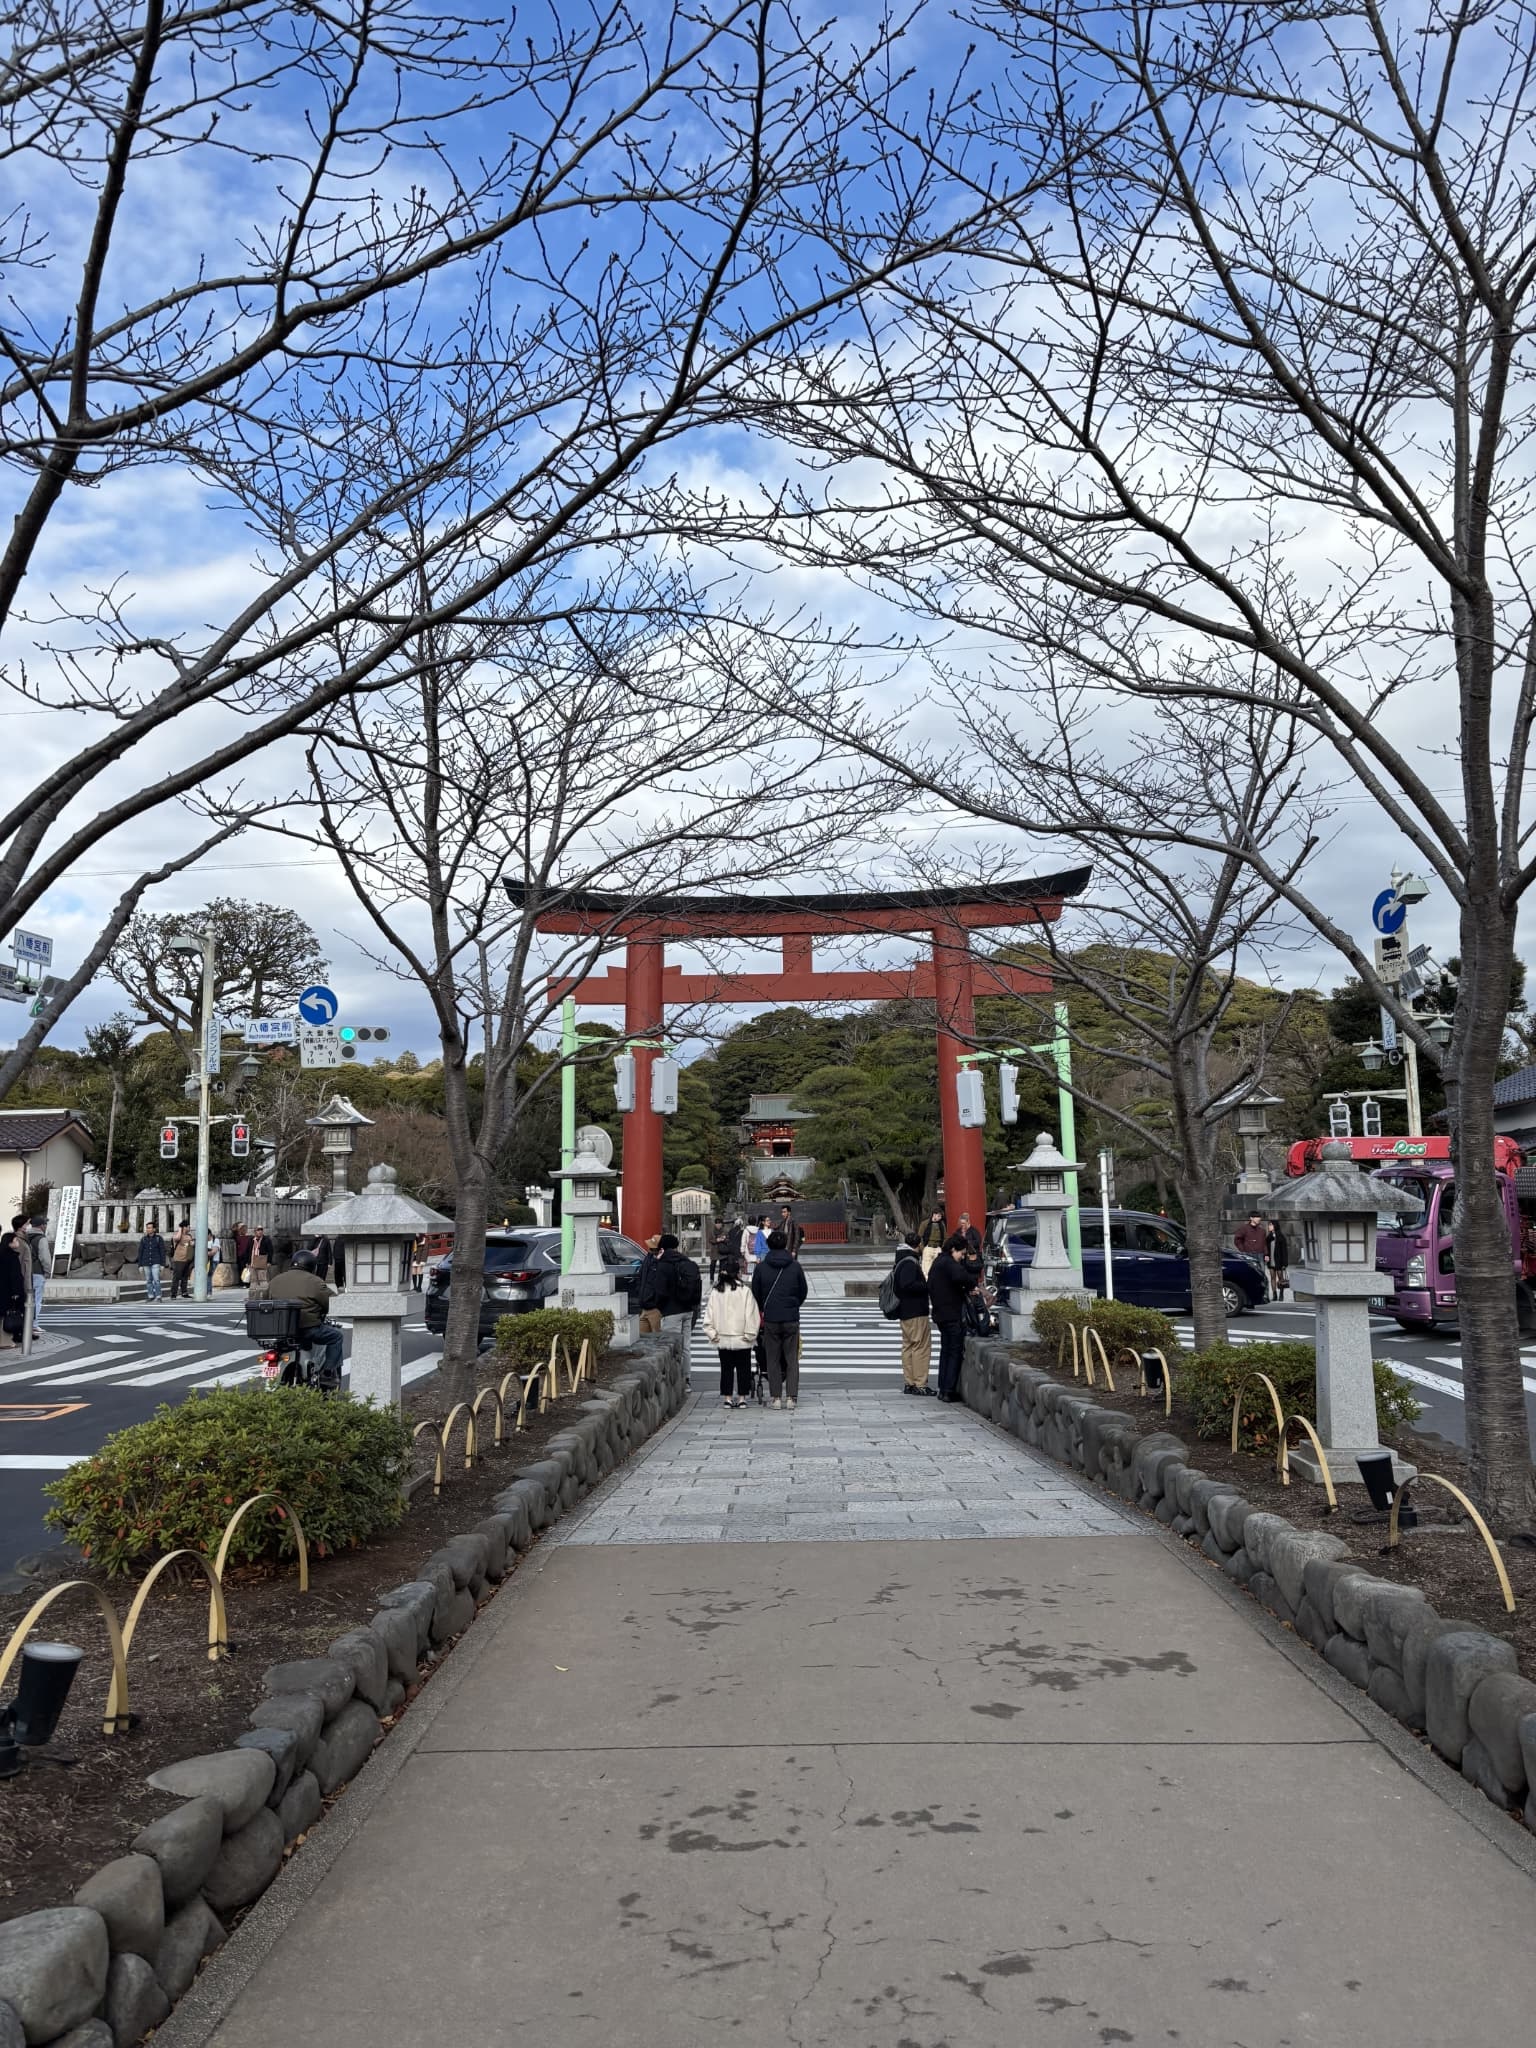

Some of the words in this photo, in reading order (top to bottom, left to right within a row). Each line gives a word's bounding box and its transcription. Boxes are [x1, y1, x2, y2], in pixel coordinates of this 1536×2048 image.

[16, 934, 50, 954] 八幡宮前
[249, 1021, 292, 1033] 八幡宮前
[209, 1021, 218, 1071] スクランブル式
